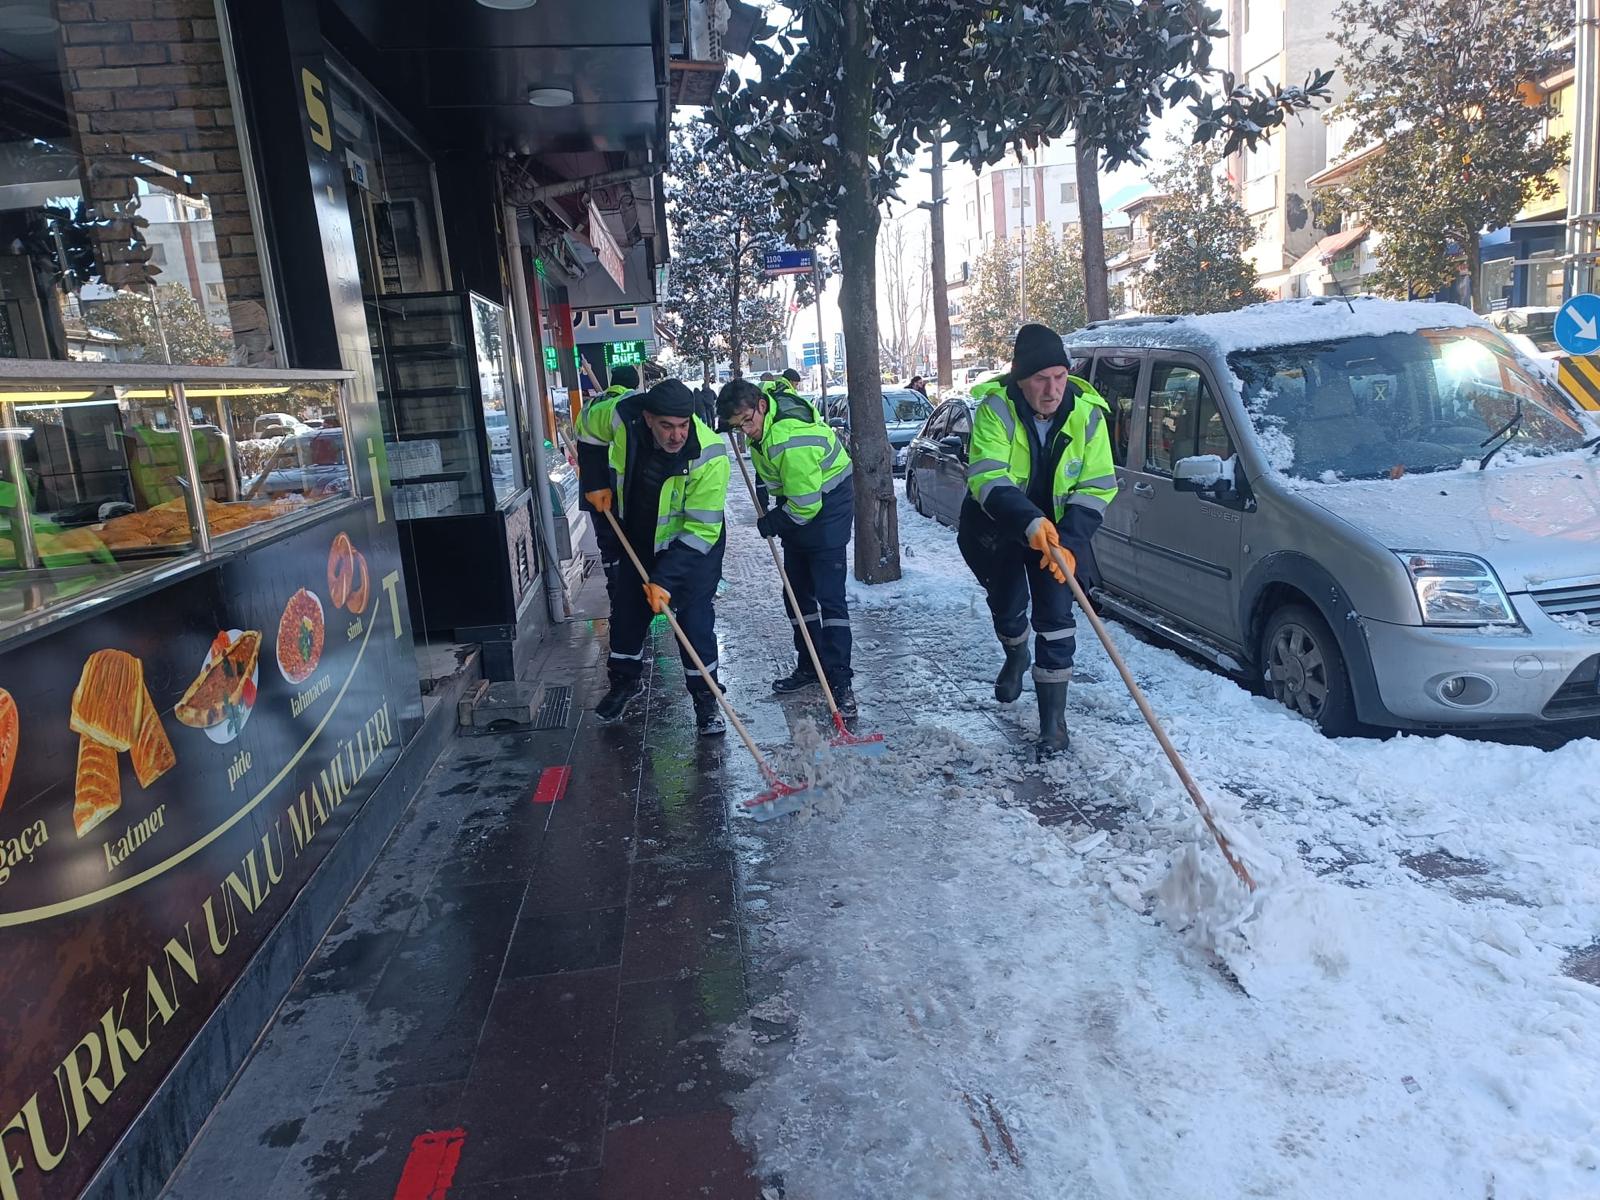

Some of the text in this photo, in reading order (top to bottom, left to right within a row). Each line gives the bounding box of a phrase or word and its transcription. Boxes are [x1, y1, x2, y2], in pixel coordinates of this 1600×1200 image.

[1199, 506, 1240, 522] SILVER
[347, 616, 363, 641] simit
[290, 674, 331, 718] lahmacun
[227, 749, 254, 792] pide
[103, 802, 166, 873] katmer
[0, 694, 393, 1200] FURKAN UNLU MAMÜLLERİ
